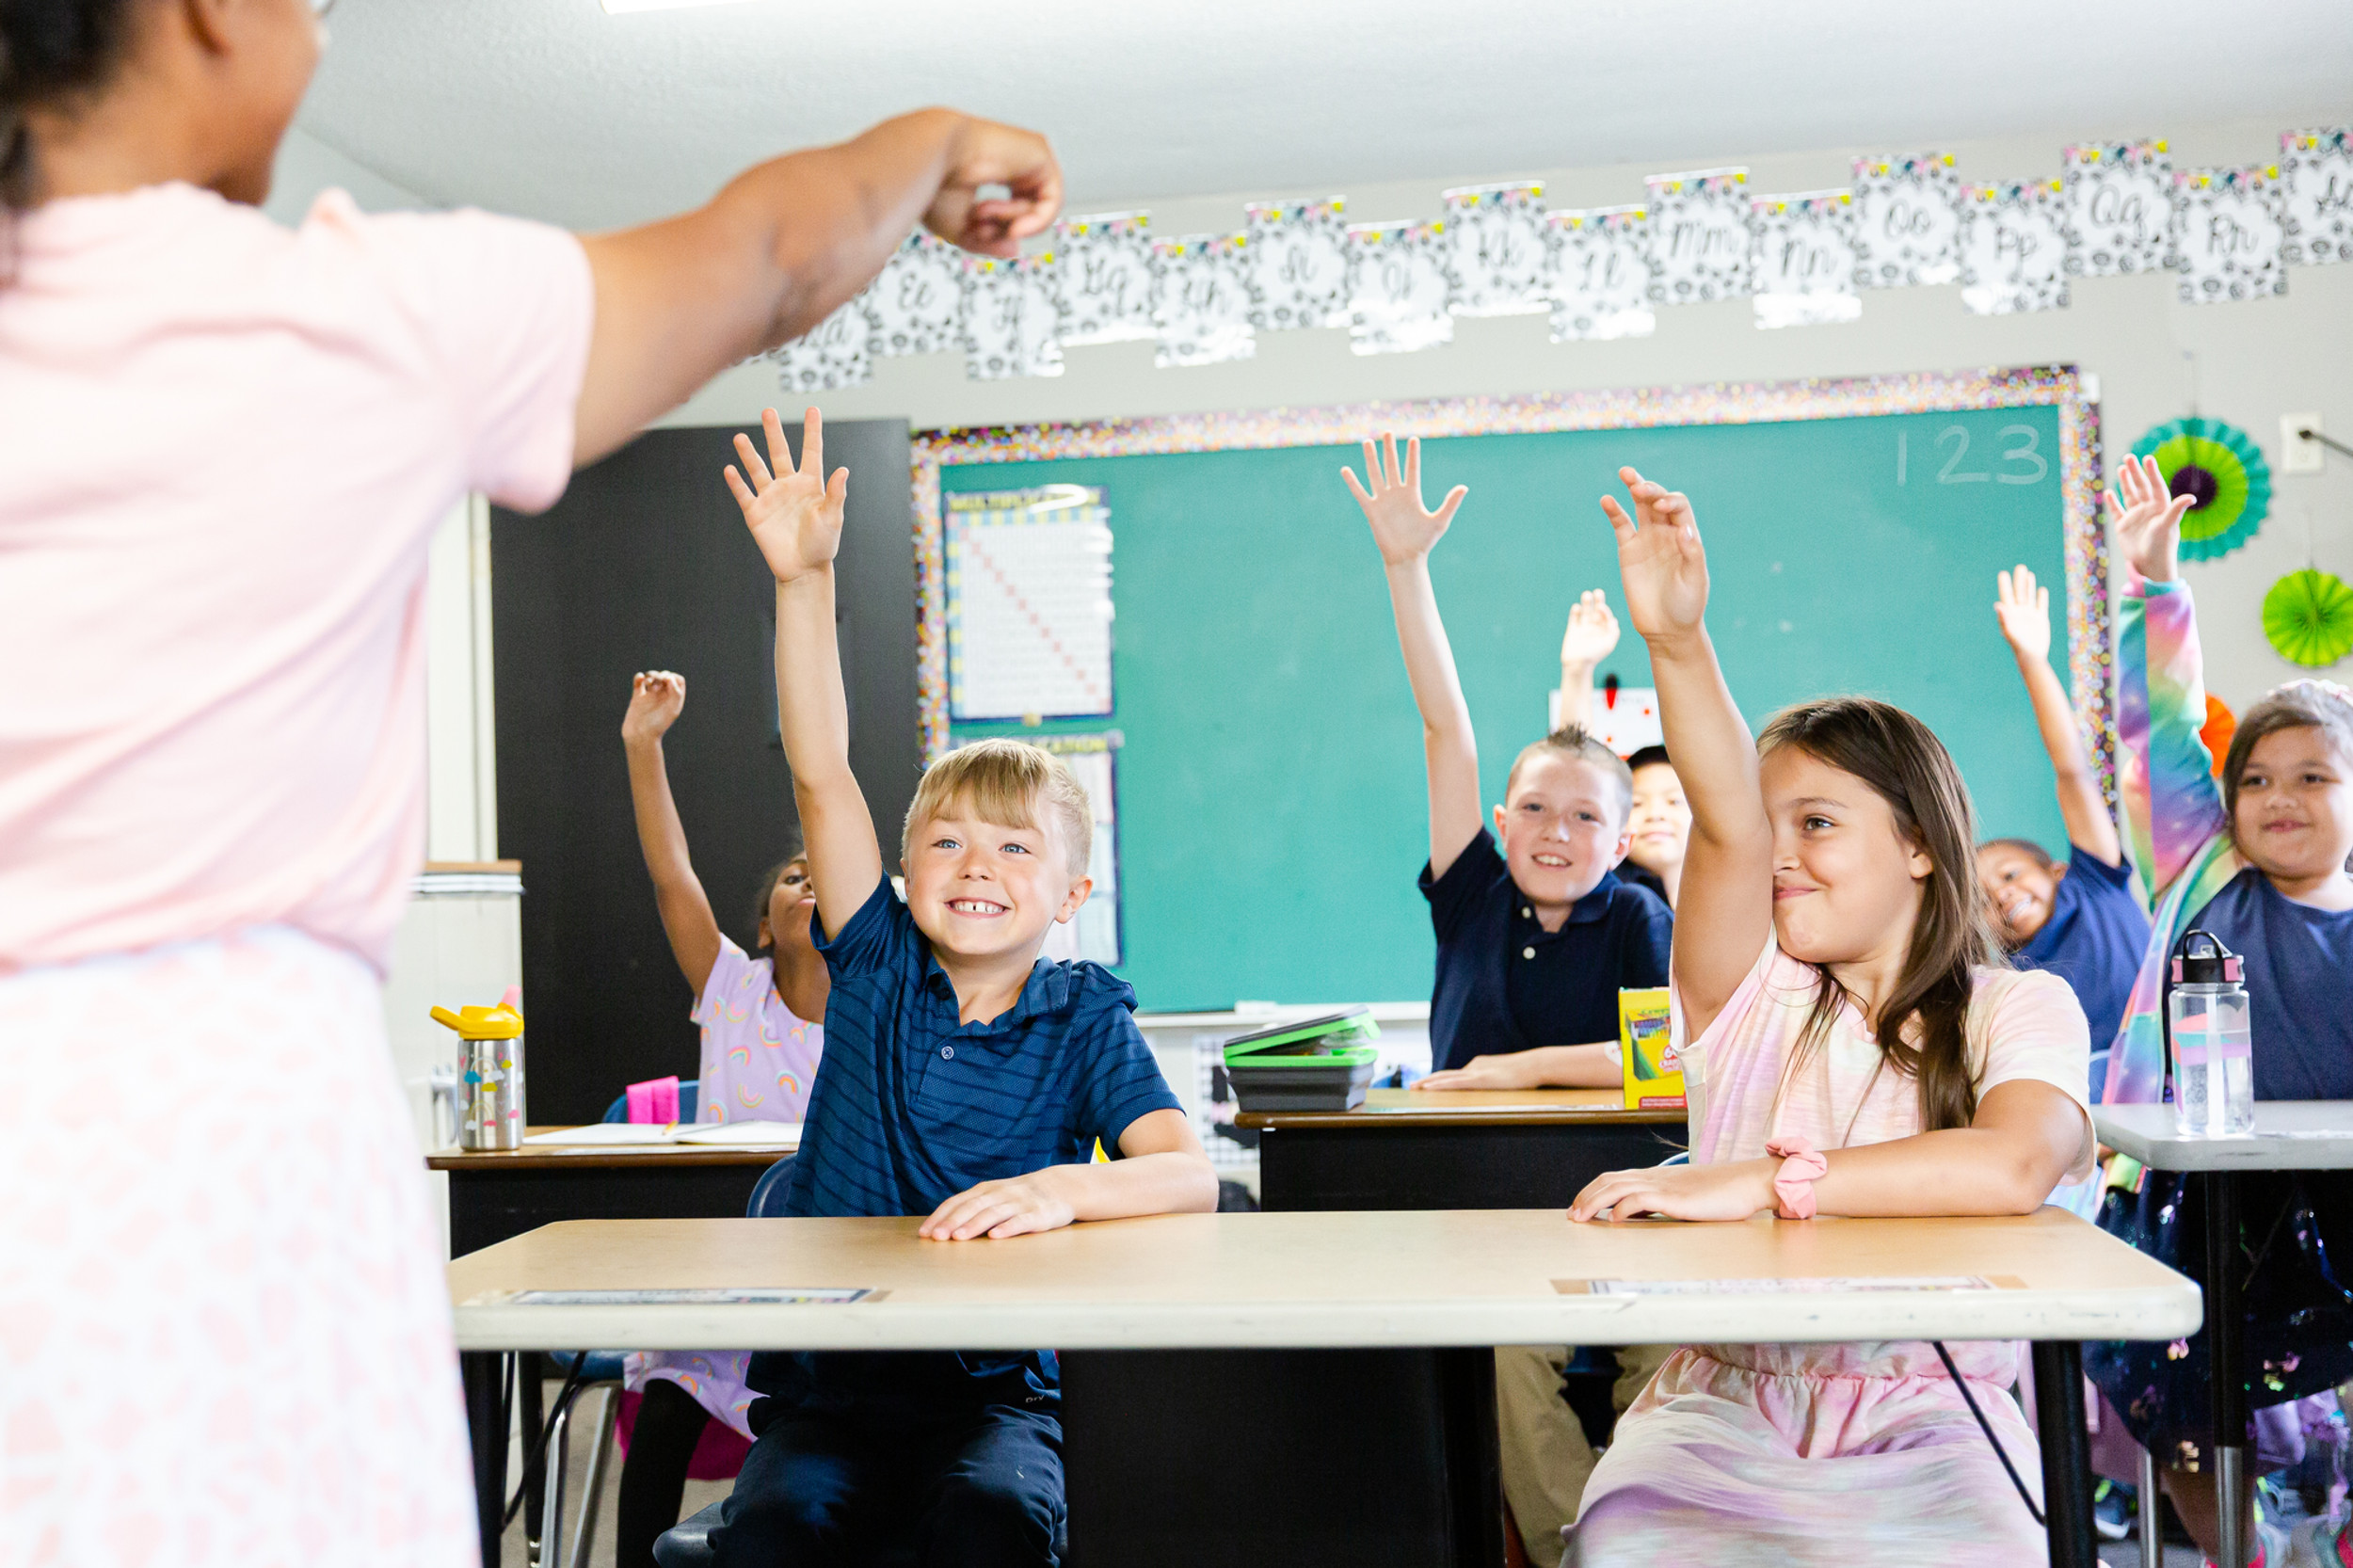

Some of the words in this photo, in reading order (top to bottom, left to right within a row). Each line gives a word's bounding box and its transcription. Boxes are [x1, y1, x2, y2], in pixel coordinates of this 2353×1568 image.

[1882, 195, 1932, 238] Oo
[1668, 218, 1740, 259] Mm
[1780, 239, 1840, 279] Nn
[1993, 223, 2041, 264] Pp
